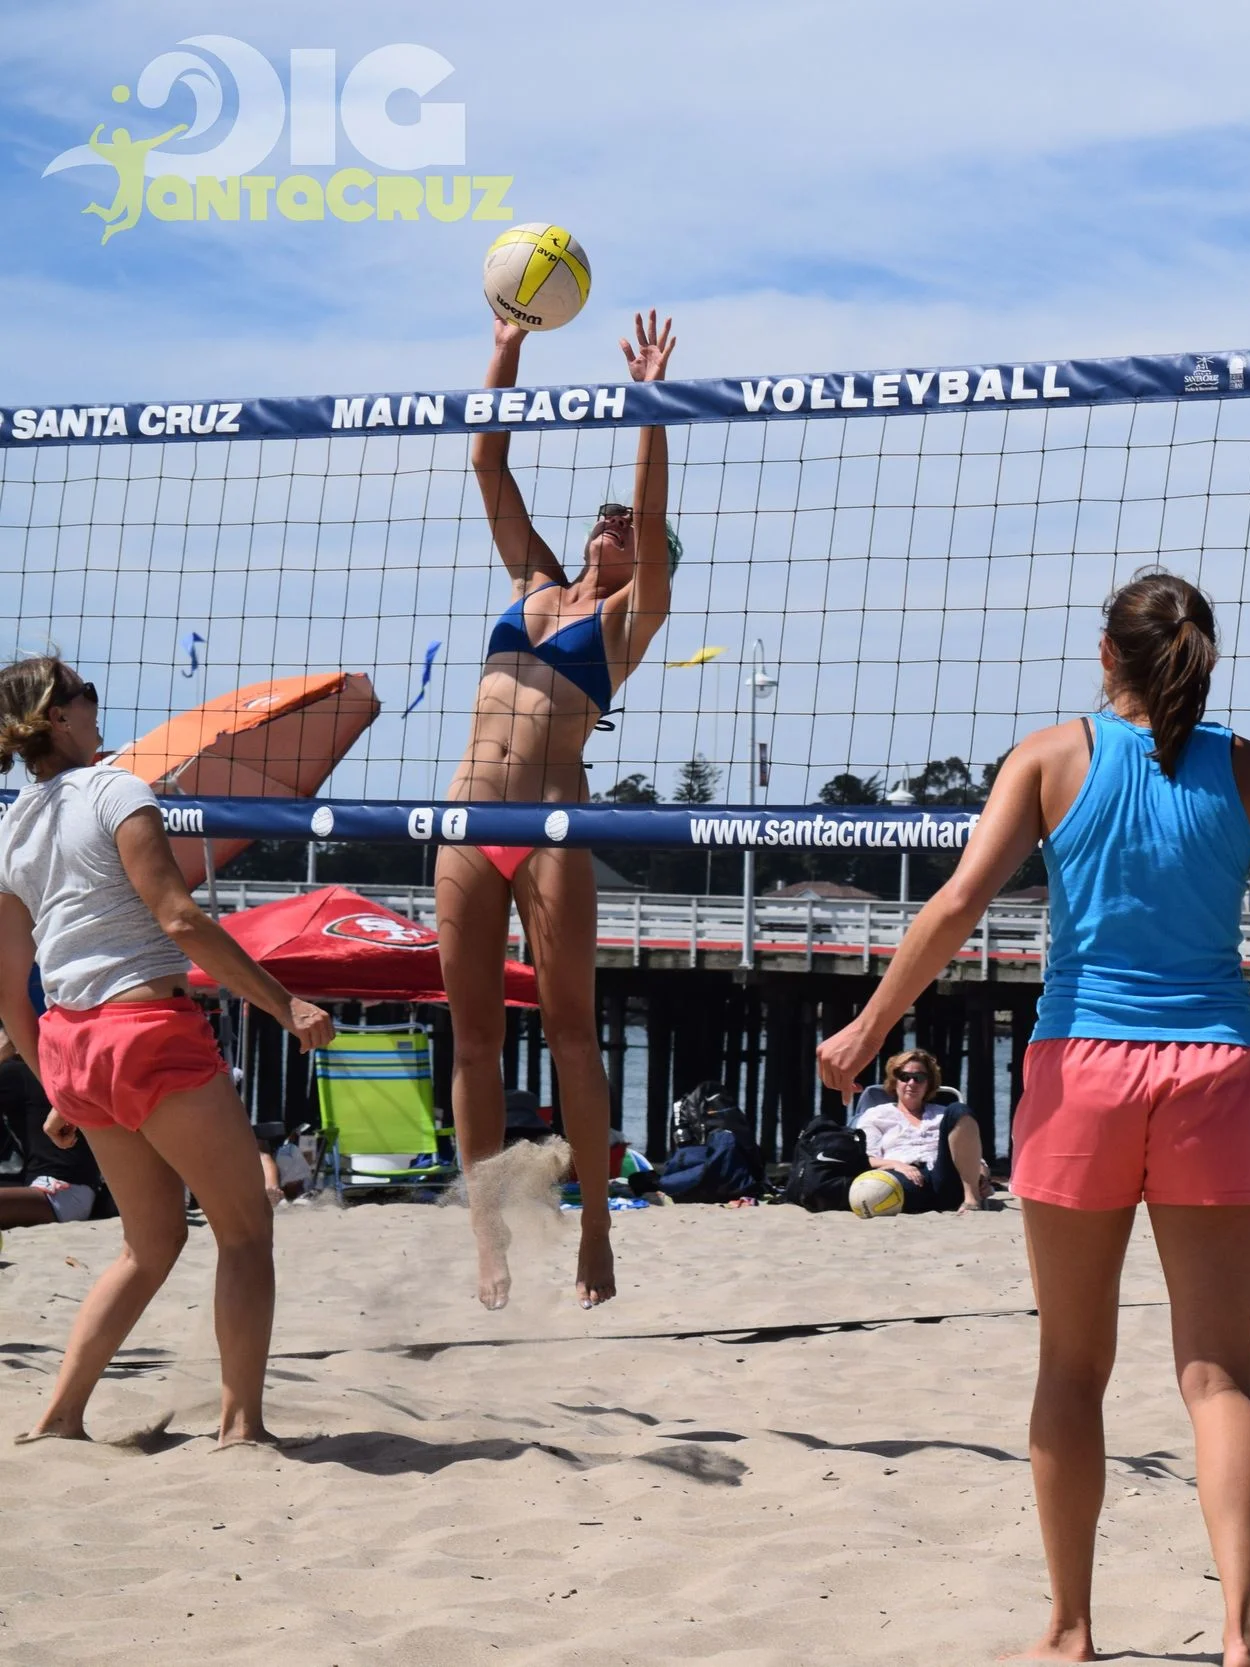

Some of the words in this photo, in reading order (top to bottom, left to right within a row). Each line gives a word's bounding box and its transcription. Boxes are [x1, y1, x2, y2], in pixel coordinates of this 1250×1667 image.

[537, 246, 558, 262] avp
[496, 293, 543, 326] Wilson
[11, 407, 128, 439] SANTA
[137, 402, 242, 434] CRUZ
[331, 397, 445, 430] MAIN
[463, 387, 626, 425] BEACH
[740, 364, 1070, 413] VOLLEYBALL
[690, 813, 981, 849] www.santacruzwharf
